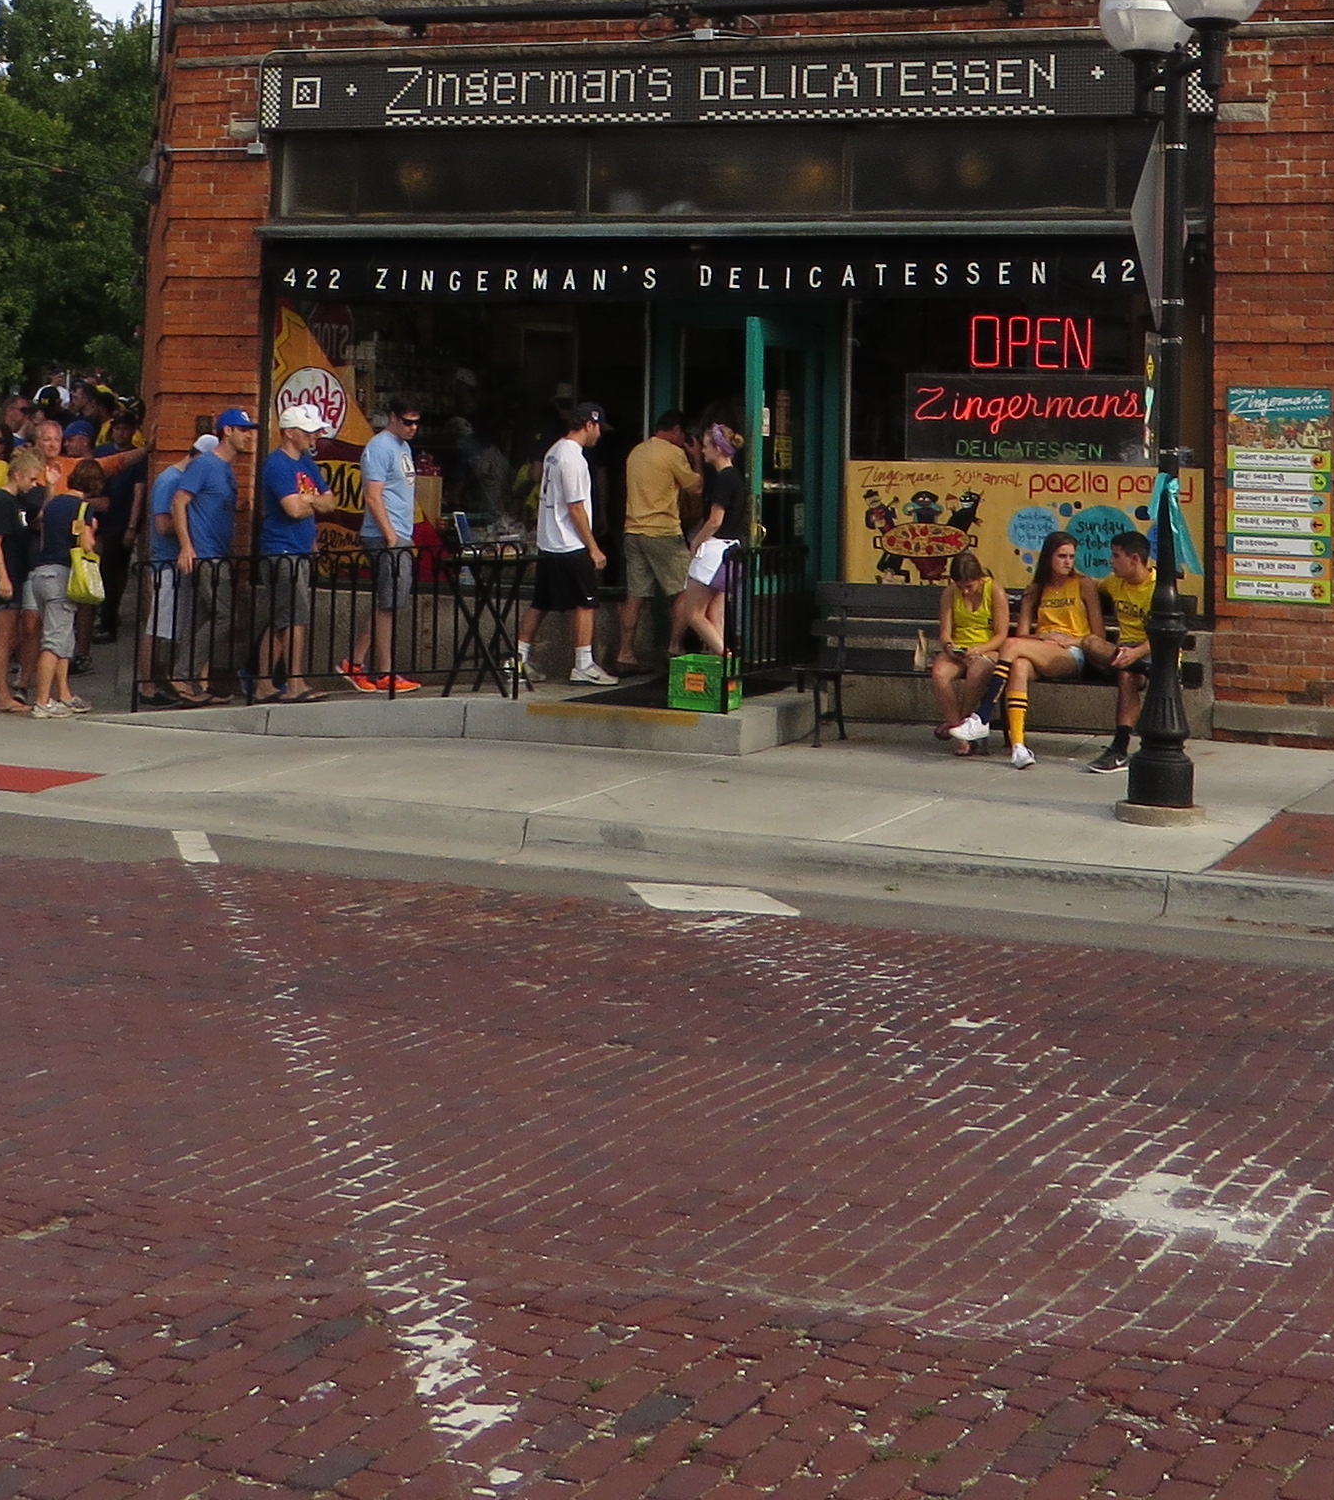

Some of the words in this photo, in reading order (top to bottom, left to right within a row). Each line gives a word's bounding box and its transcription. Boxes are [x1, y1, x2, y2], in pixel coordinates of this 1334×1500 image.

[385, 64, 673, 116] Zingerman's
[699, 54, 1057, 101] DELICATESSEN
[282, 267, 343, 290] 422
[374, 264, 658, 292] ZINGERMAN'S
[699, 260, 1048, 290] DELICATESSEN
[1091, 258, 1138, 284] 42
[970, 315, 1094, 369] OPEN
[914, 386, 1145, 435] Zingerman's
[1230, 391, 1326, 416] Zingerman's
[955, 439, 1103, 460] DELICATESSEN
[952, 468, 982, 488] 30th
[1028, 471, 1109, 499] paella
[1117, 475, 1195, 503] pay
[1078, 534, 1110, 551] ctobe
[1041, 597, 1076, 608] ICHIGAN
